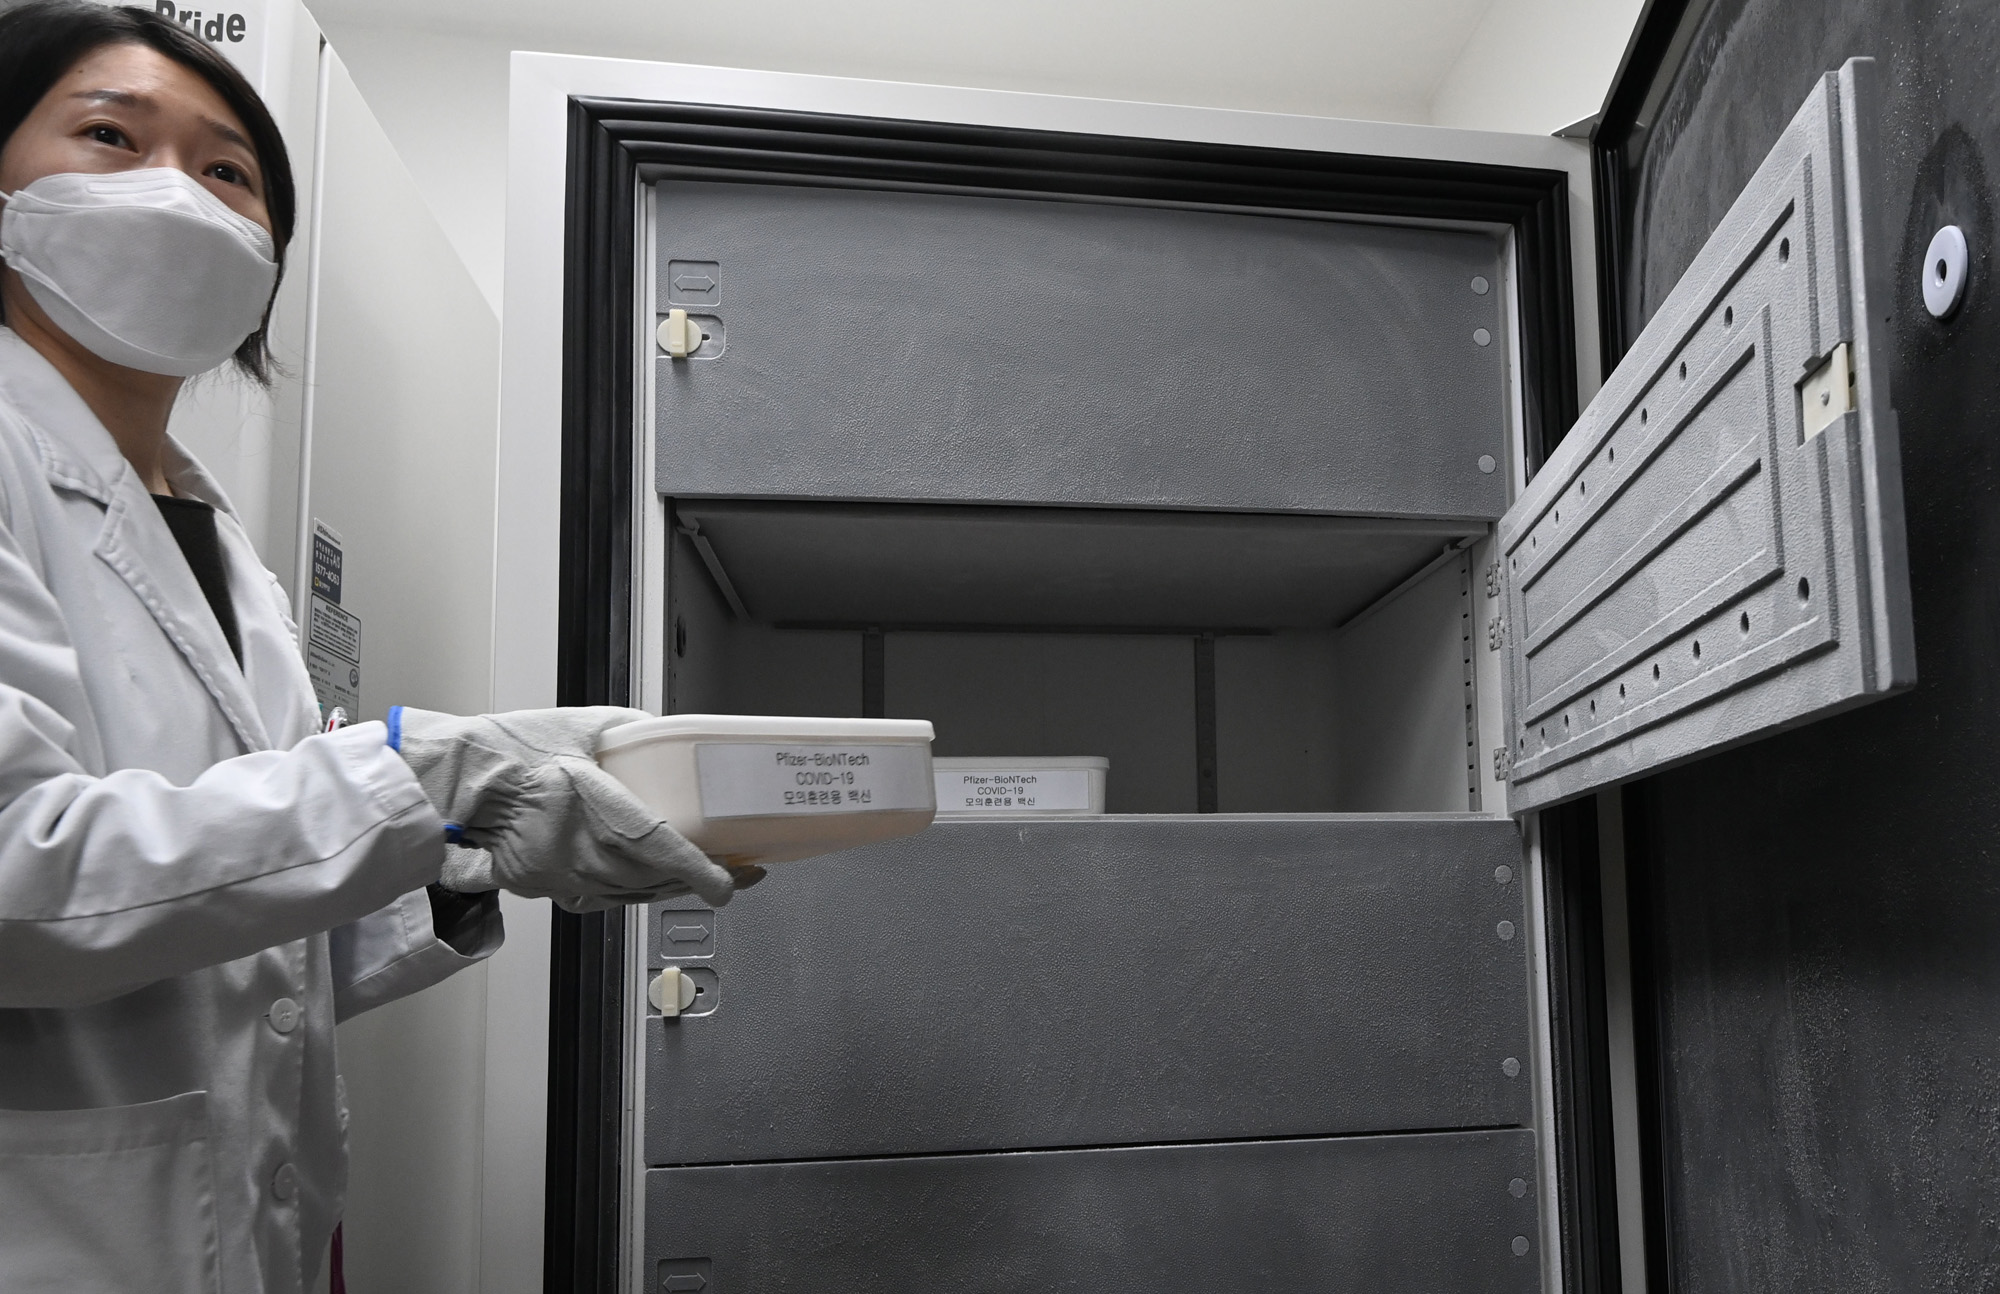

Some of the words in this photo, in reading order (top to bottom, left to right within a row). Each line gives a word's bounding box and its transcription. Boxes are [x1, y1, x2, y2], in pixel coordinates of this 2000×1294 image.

[156, 0, 246, 43] Pride
[775, 752, 870, 767] Pfizer-BioNTech
[795, 771, 855, 786] COVID-19
[963, 775, 1037, 785] Pfizer-BioNTech
[783, 789, 842, 805] 모의훈련용
[847, 789, 872, 804] 백신
[977, 786, 1024, 796] COVID-19
[965, 797, 1012, 807] 모의훈련용
[1017, 797, 1036, 807] 백신
